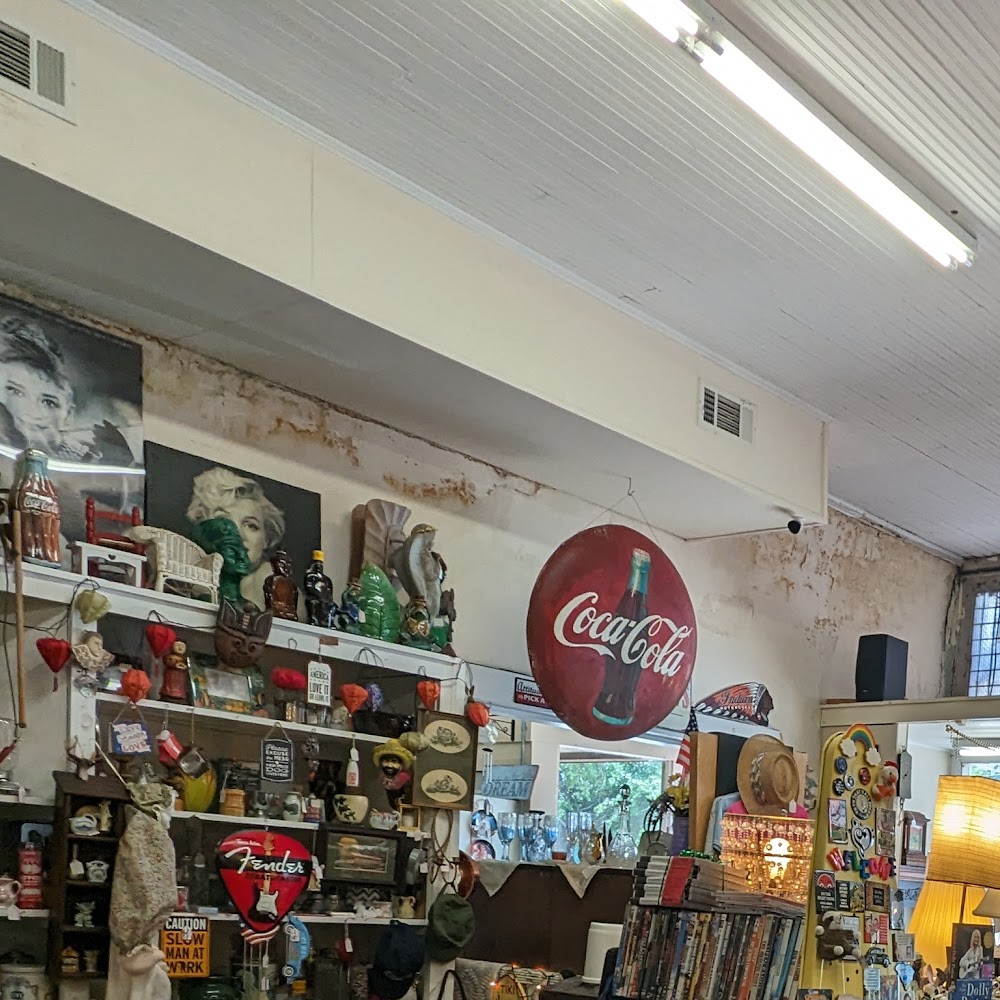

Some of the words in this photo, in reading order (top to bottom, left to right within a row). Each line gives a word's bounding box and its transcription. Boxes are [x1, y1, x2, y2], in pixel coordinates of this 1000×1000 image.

[310, 682, 323, 694] LOVE
[523, 694, 539, 703] PICK
[224, 845, 304, 875] Fender
[166, 917, 206, 931] CAUTION
[166, 947, 190, 959] MAN
[192, 947, 205, 959] AT
[501, 984, 515, 995] TIKI
[966, 982, 990, 999] Dolly
